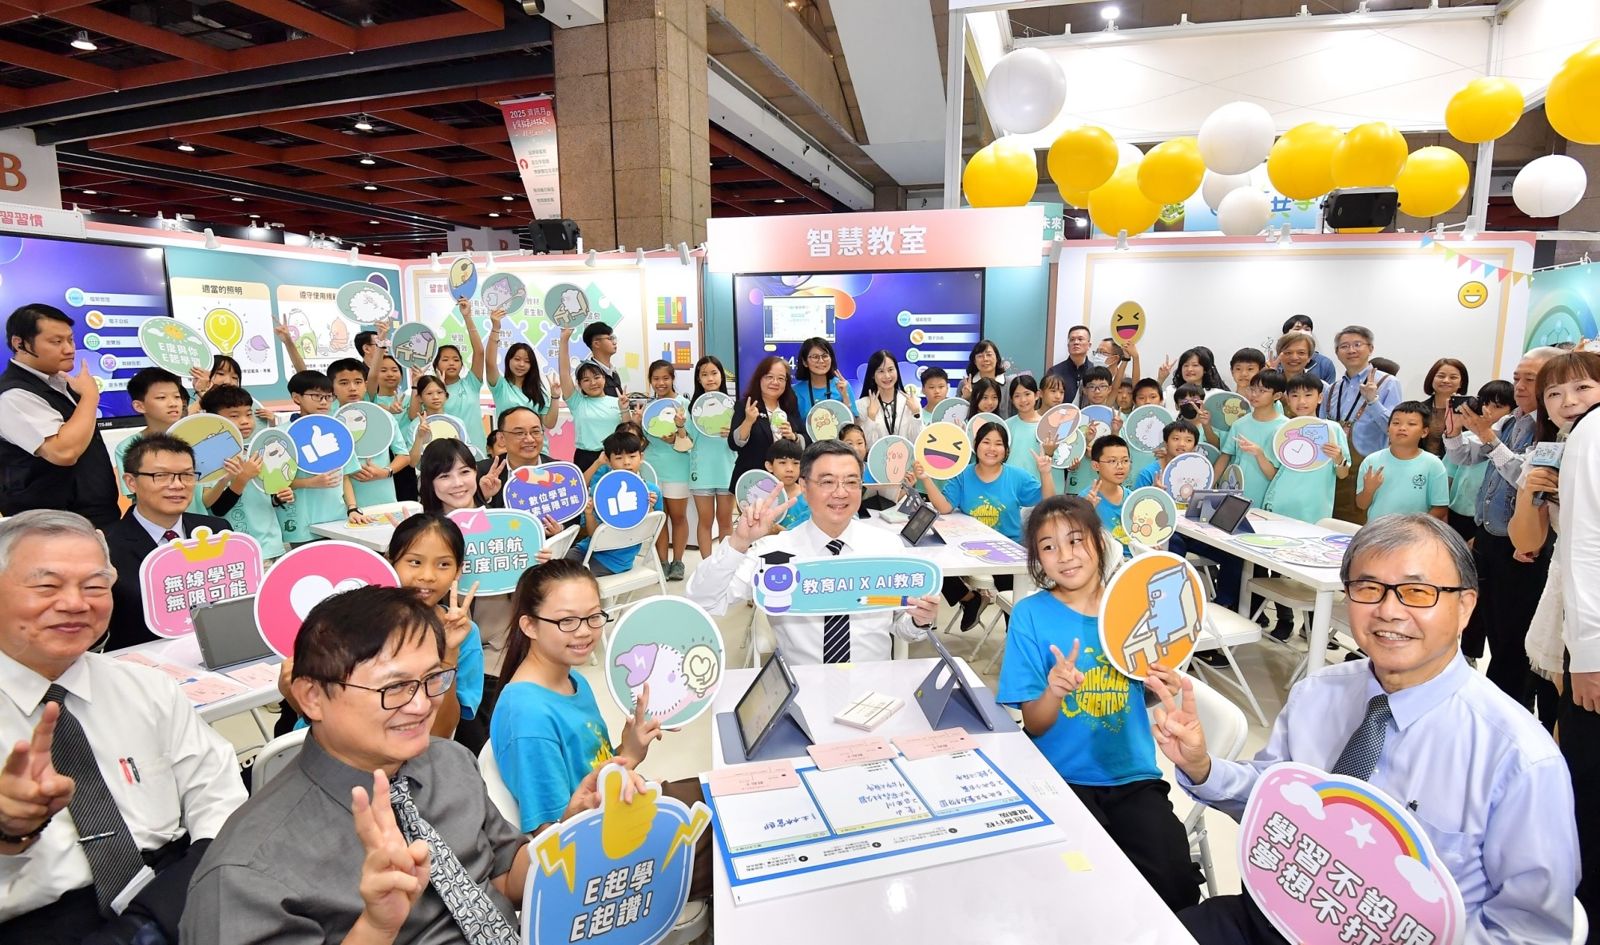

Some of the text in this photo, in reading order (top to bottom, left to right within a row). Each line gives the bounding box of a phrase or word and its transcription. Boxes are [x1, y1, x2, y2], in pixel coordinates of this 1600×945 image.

[510, 110, 526, 118] 2025
[0, 153, 27, 192] B
[806, 225, 928, 258] 智慧教室
[202, 284, 243, 296] 適當的照明
[526, 494, 580, 517] 索無限可能
[528, 487, 567, 506] 數位學習
[465, 536, 524, 556] AI領航
[164, 561, 246, 594] 無線學習
[802, 572, 926, 595] 教育AI X AI教育
[166, 579, 248, 613] 無限可能
[582, 858, 656, 906] E起學
[1249, 836, 1394, 945] 夢想不打
[1263, 811, 1436, 945] 學習不設限
[569, 890, 654, 944] E起讚!
